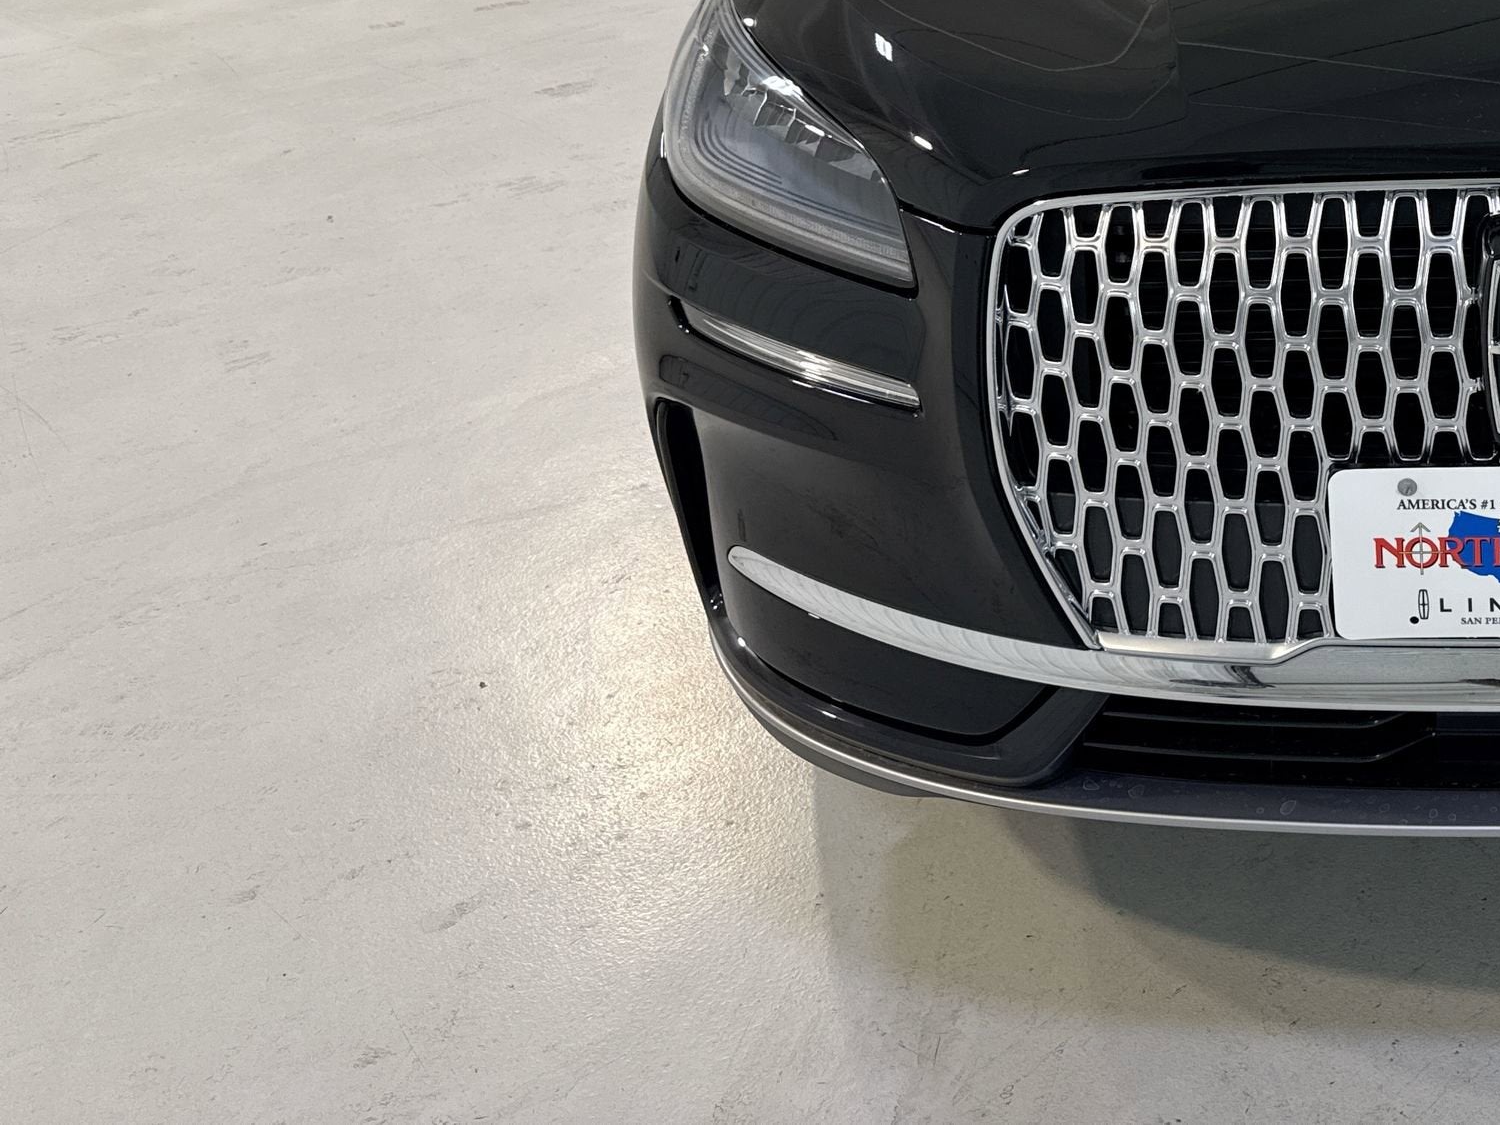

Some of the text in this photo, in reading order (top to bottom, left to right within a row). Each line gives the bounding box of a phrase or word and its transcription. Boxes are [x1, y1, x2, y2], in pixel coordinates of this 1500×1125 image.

[1397, 498, 1477, 510] AMERICA'S
[1480, 498, 1496, 510] #1
[1461, 616, 1482, 625] SAN
